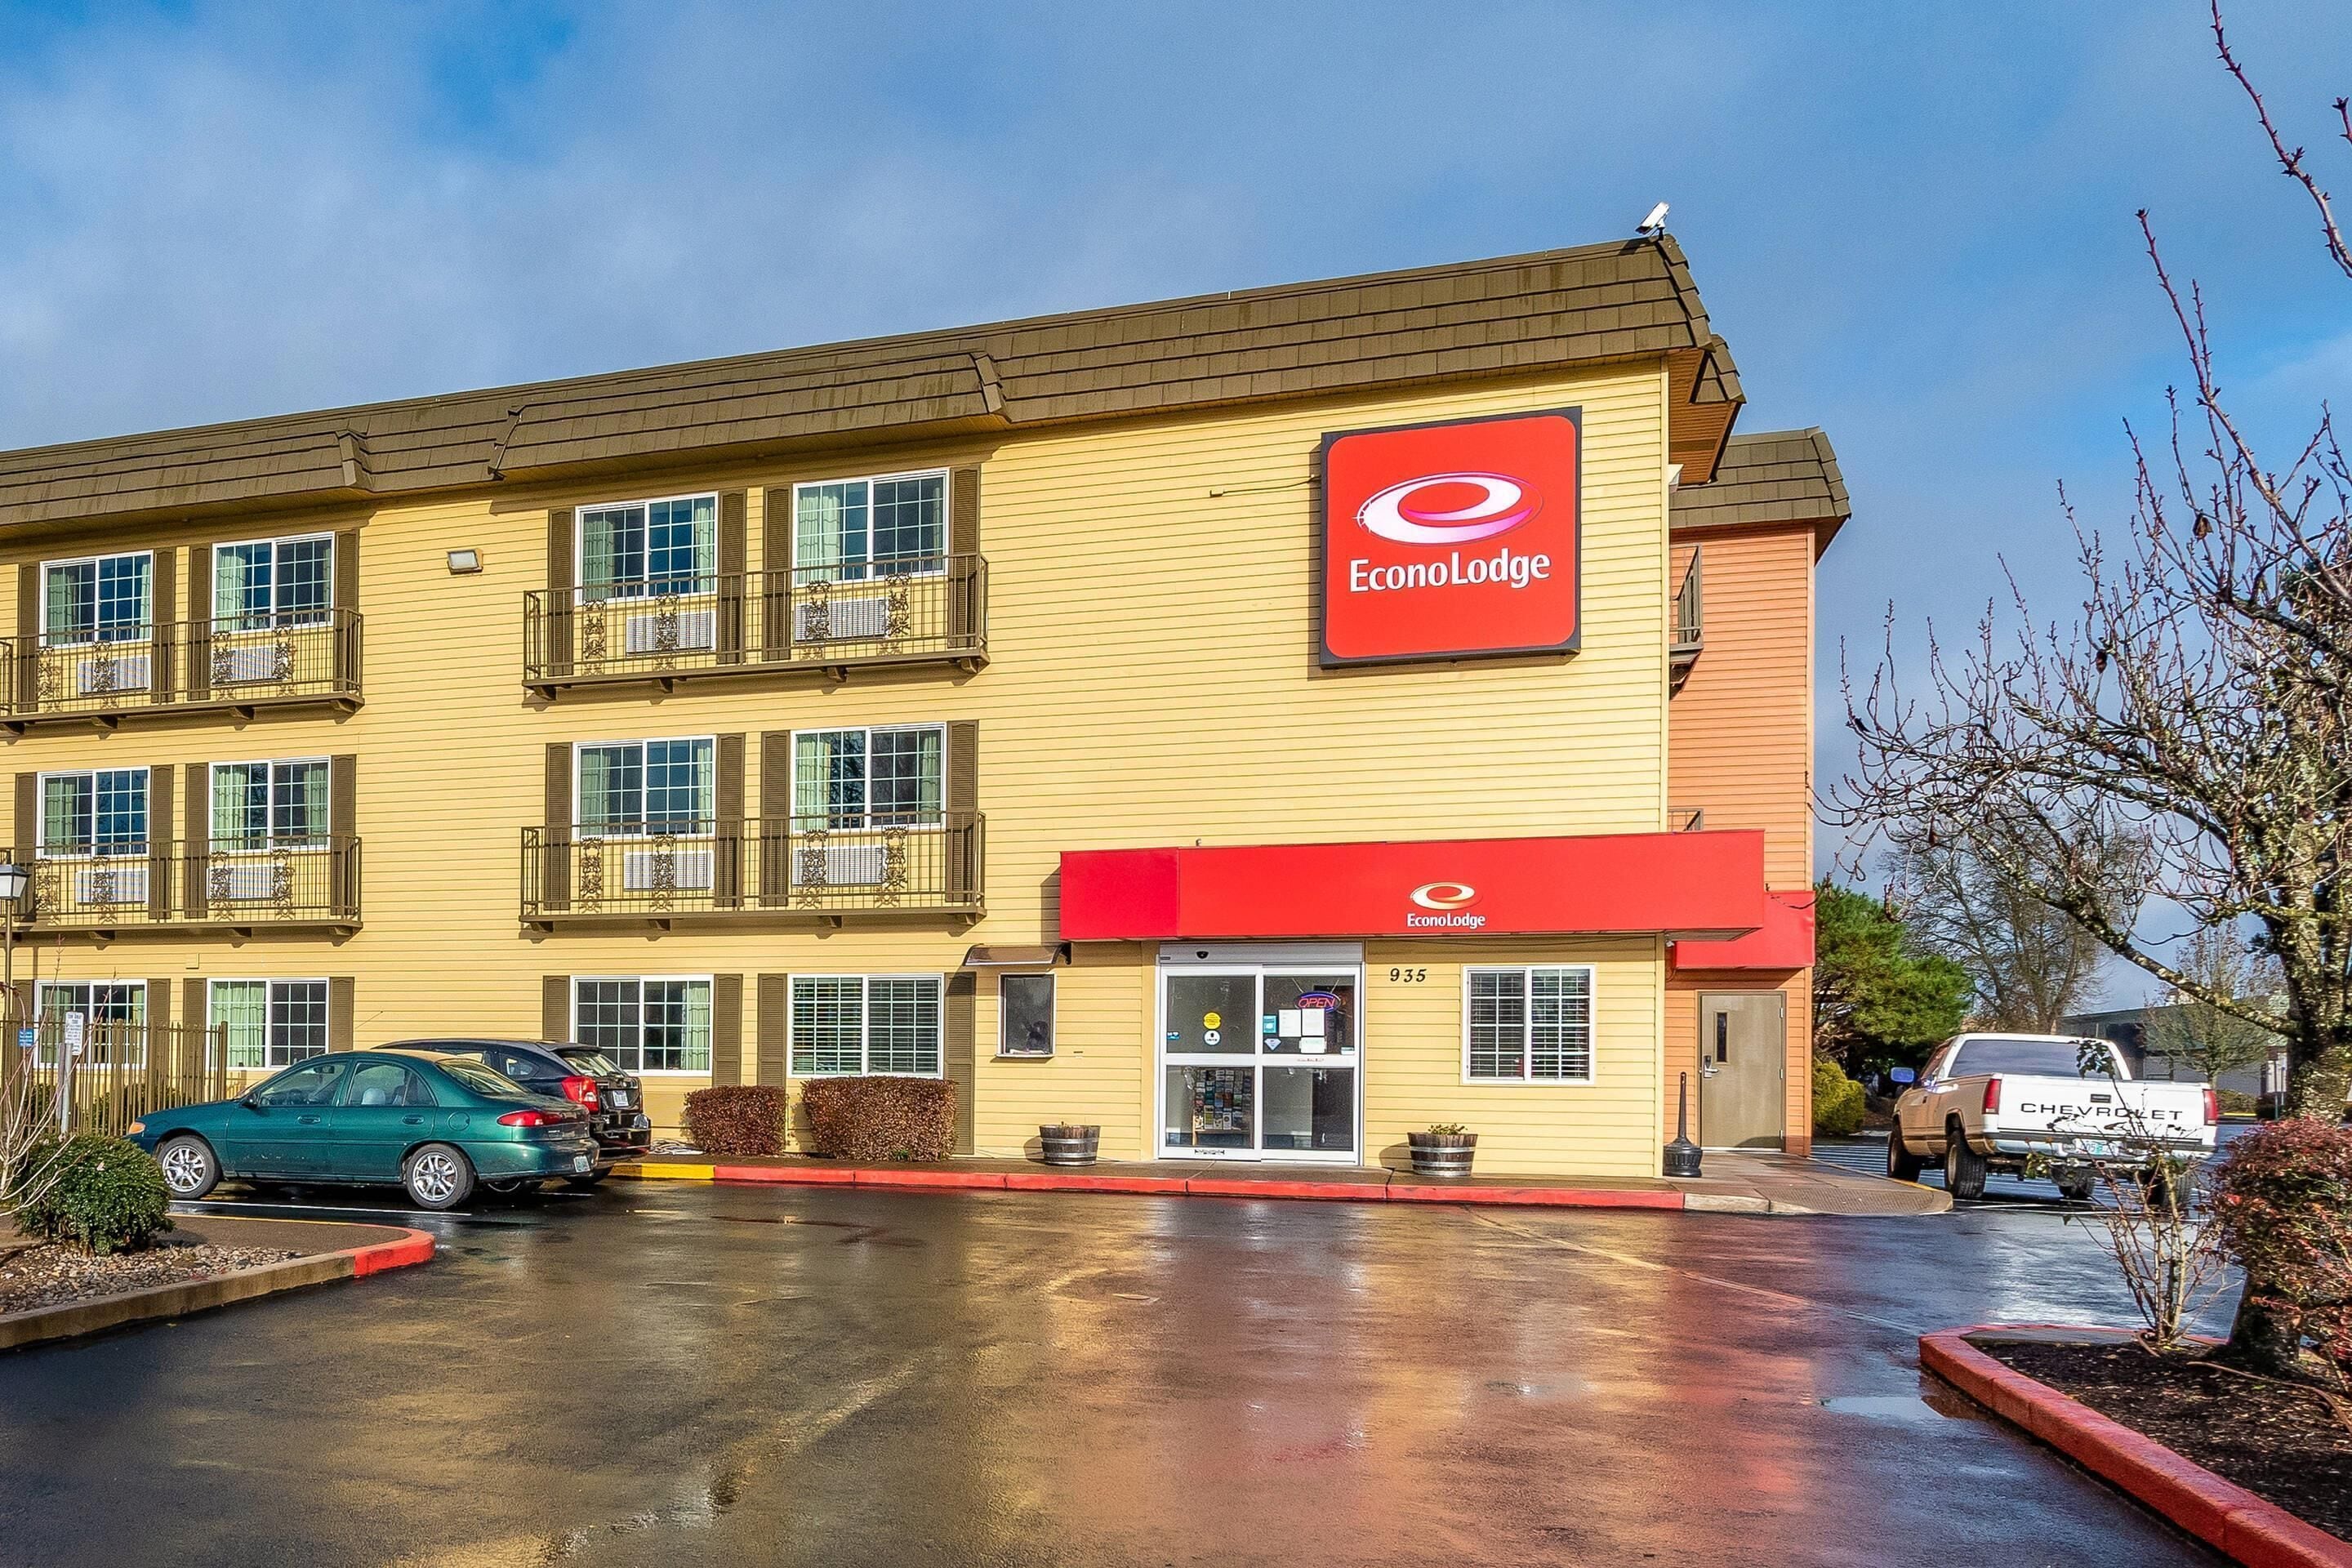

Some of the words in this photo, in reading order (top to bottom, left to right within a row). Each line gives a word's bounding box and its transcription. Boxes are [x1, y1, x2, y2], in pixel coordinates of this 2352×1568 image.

[1349, 547, 1551, 592] EconoLodge
[1406, 912, 1486, 929] EconoLodge
[1389, 968, 1427, 983] 935
[1298, 997, 1335, 1008] OPEN
[2020, 1102, 2183, 1120] CHEVROLET
